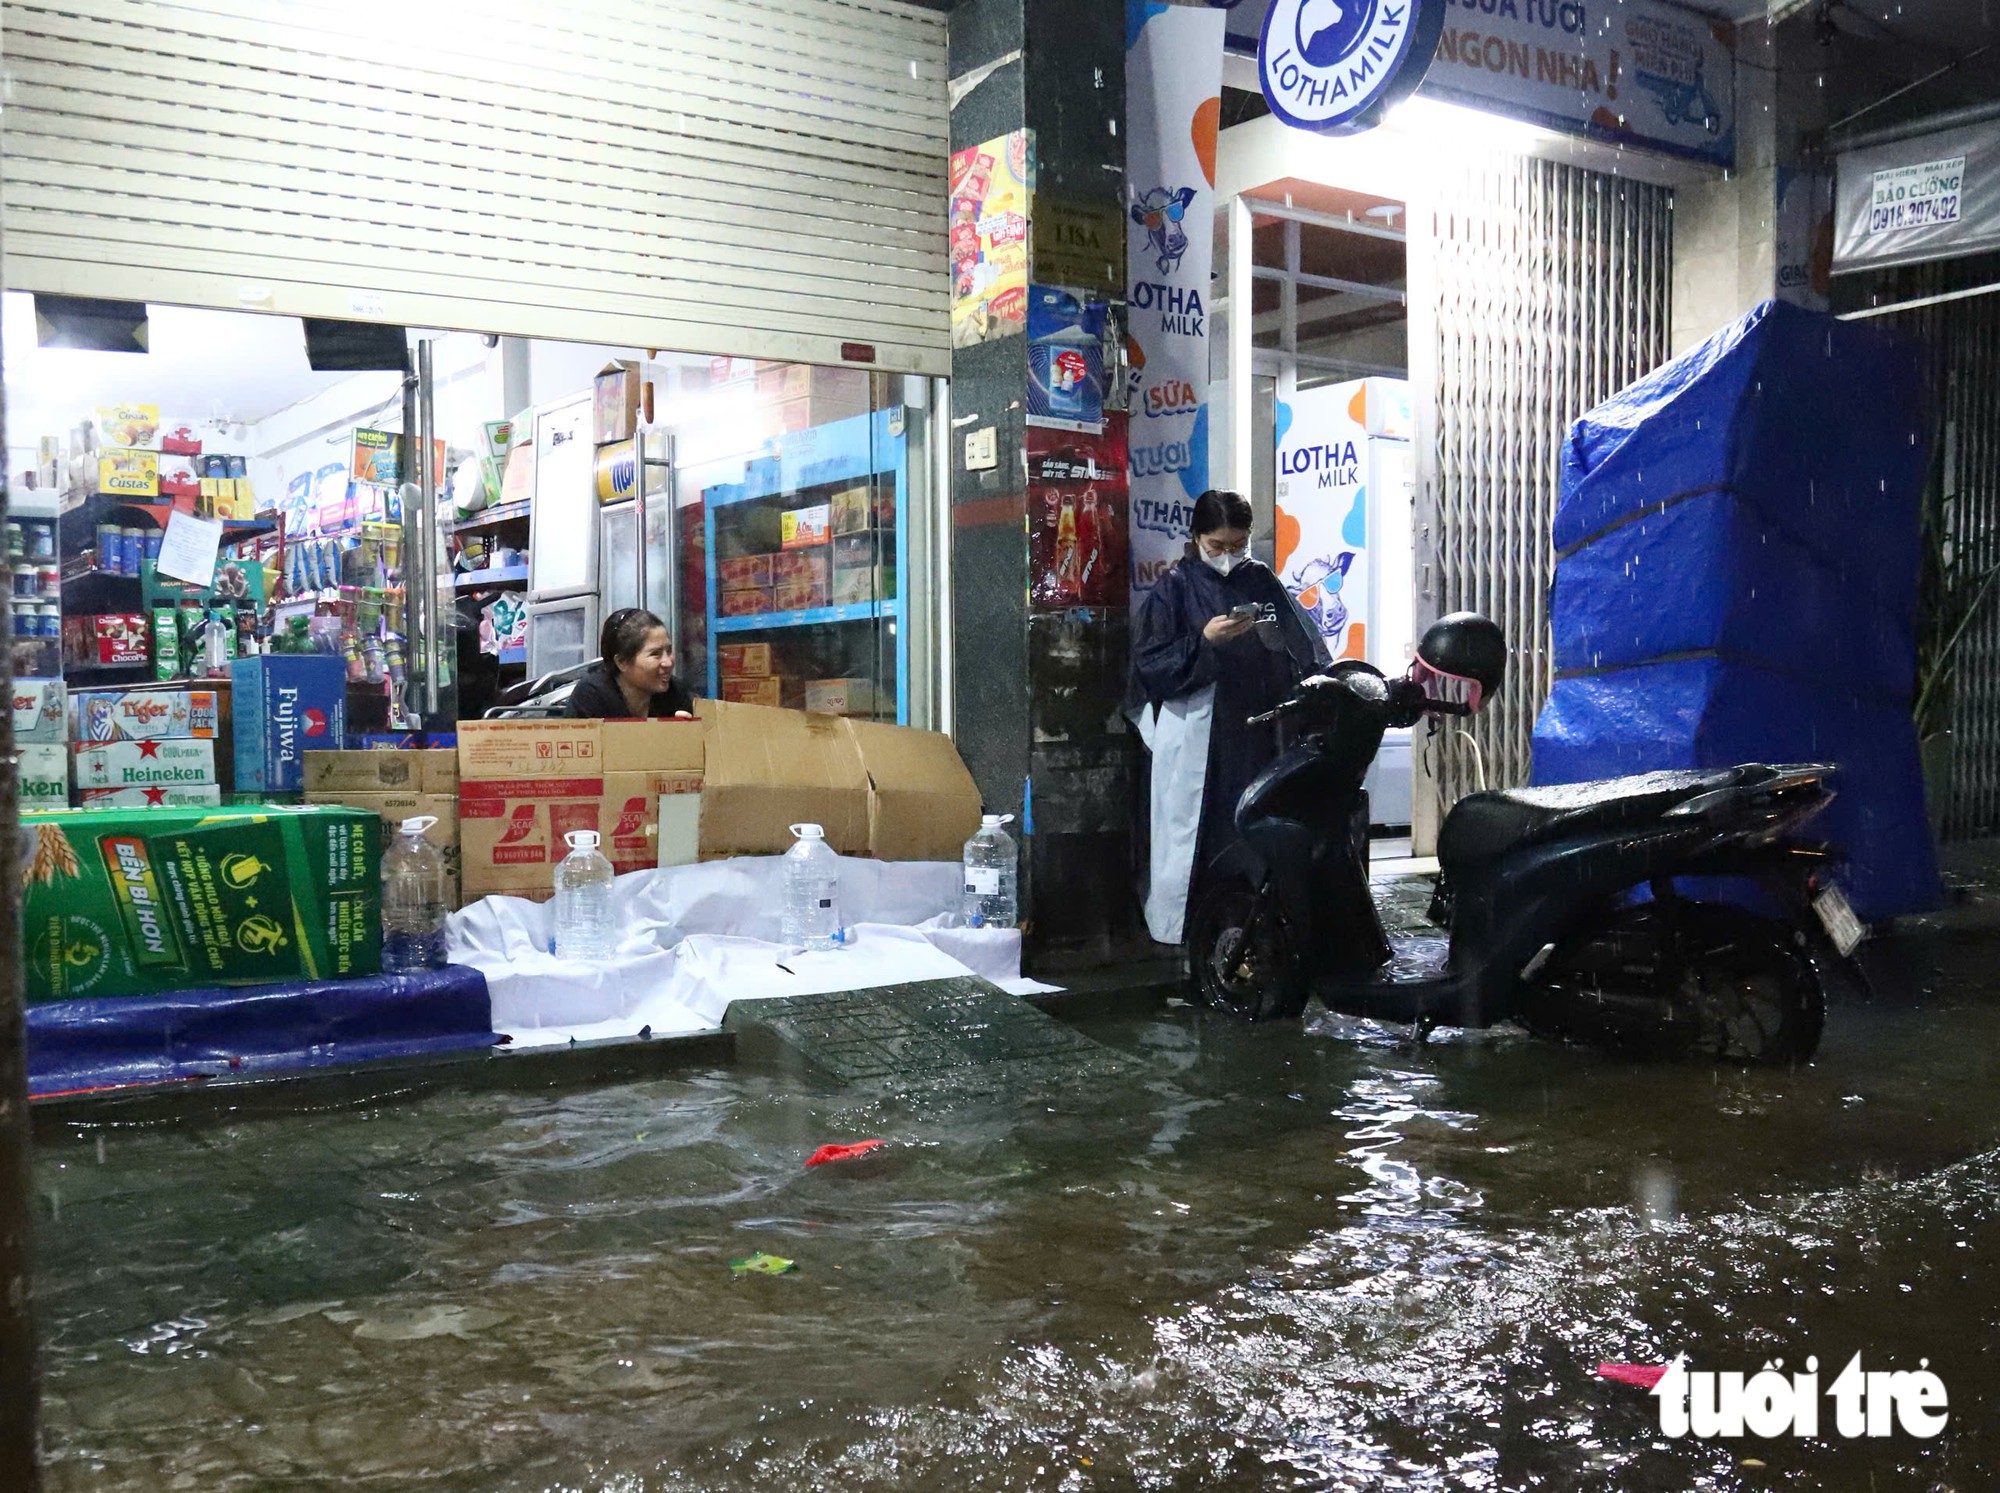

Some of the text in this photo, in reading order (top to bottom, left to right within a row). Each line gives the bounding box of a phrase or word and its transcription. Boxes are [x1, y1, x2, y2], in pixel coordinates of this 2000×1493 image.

[1272, 4, 1405, 106] LOTHAMILK
[1436, 27, 1529, 79] NGON
[1876, 181, 1905, 204] BẢO
[1161, 315, 1204, 337] MILK
[1152, 380, 1196, 409] SỮA
[1133, 441, 1188, 468] TƯƠI
[1282, 441, 1358, 475] LOTHA
[108, 477, 150, 489] Custas
[1318, 466, 1358, 489] MILK
[121, 698, 169, 724] Tiger
[273, 687, 298, 762] Fujiwa
[122, 766, 205, 783] Heineken
[352, 824, 363, 838] MẸ
[353, 841, 365, 854] CÓ
[114, 842, 166, 954] BỀN BỈ HƠN
[203, 881, 219, 904] MILO
